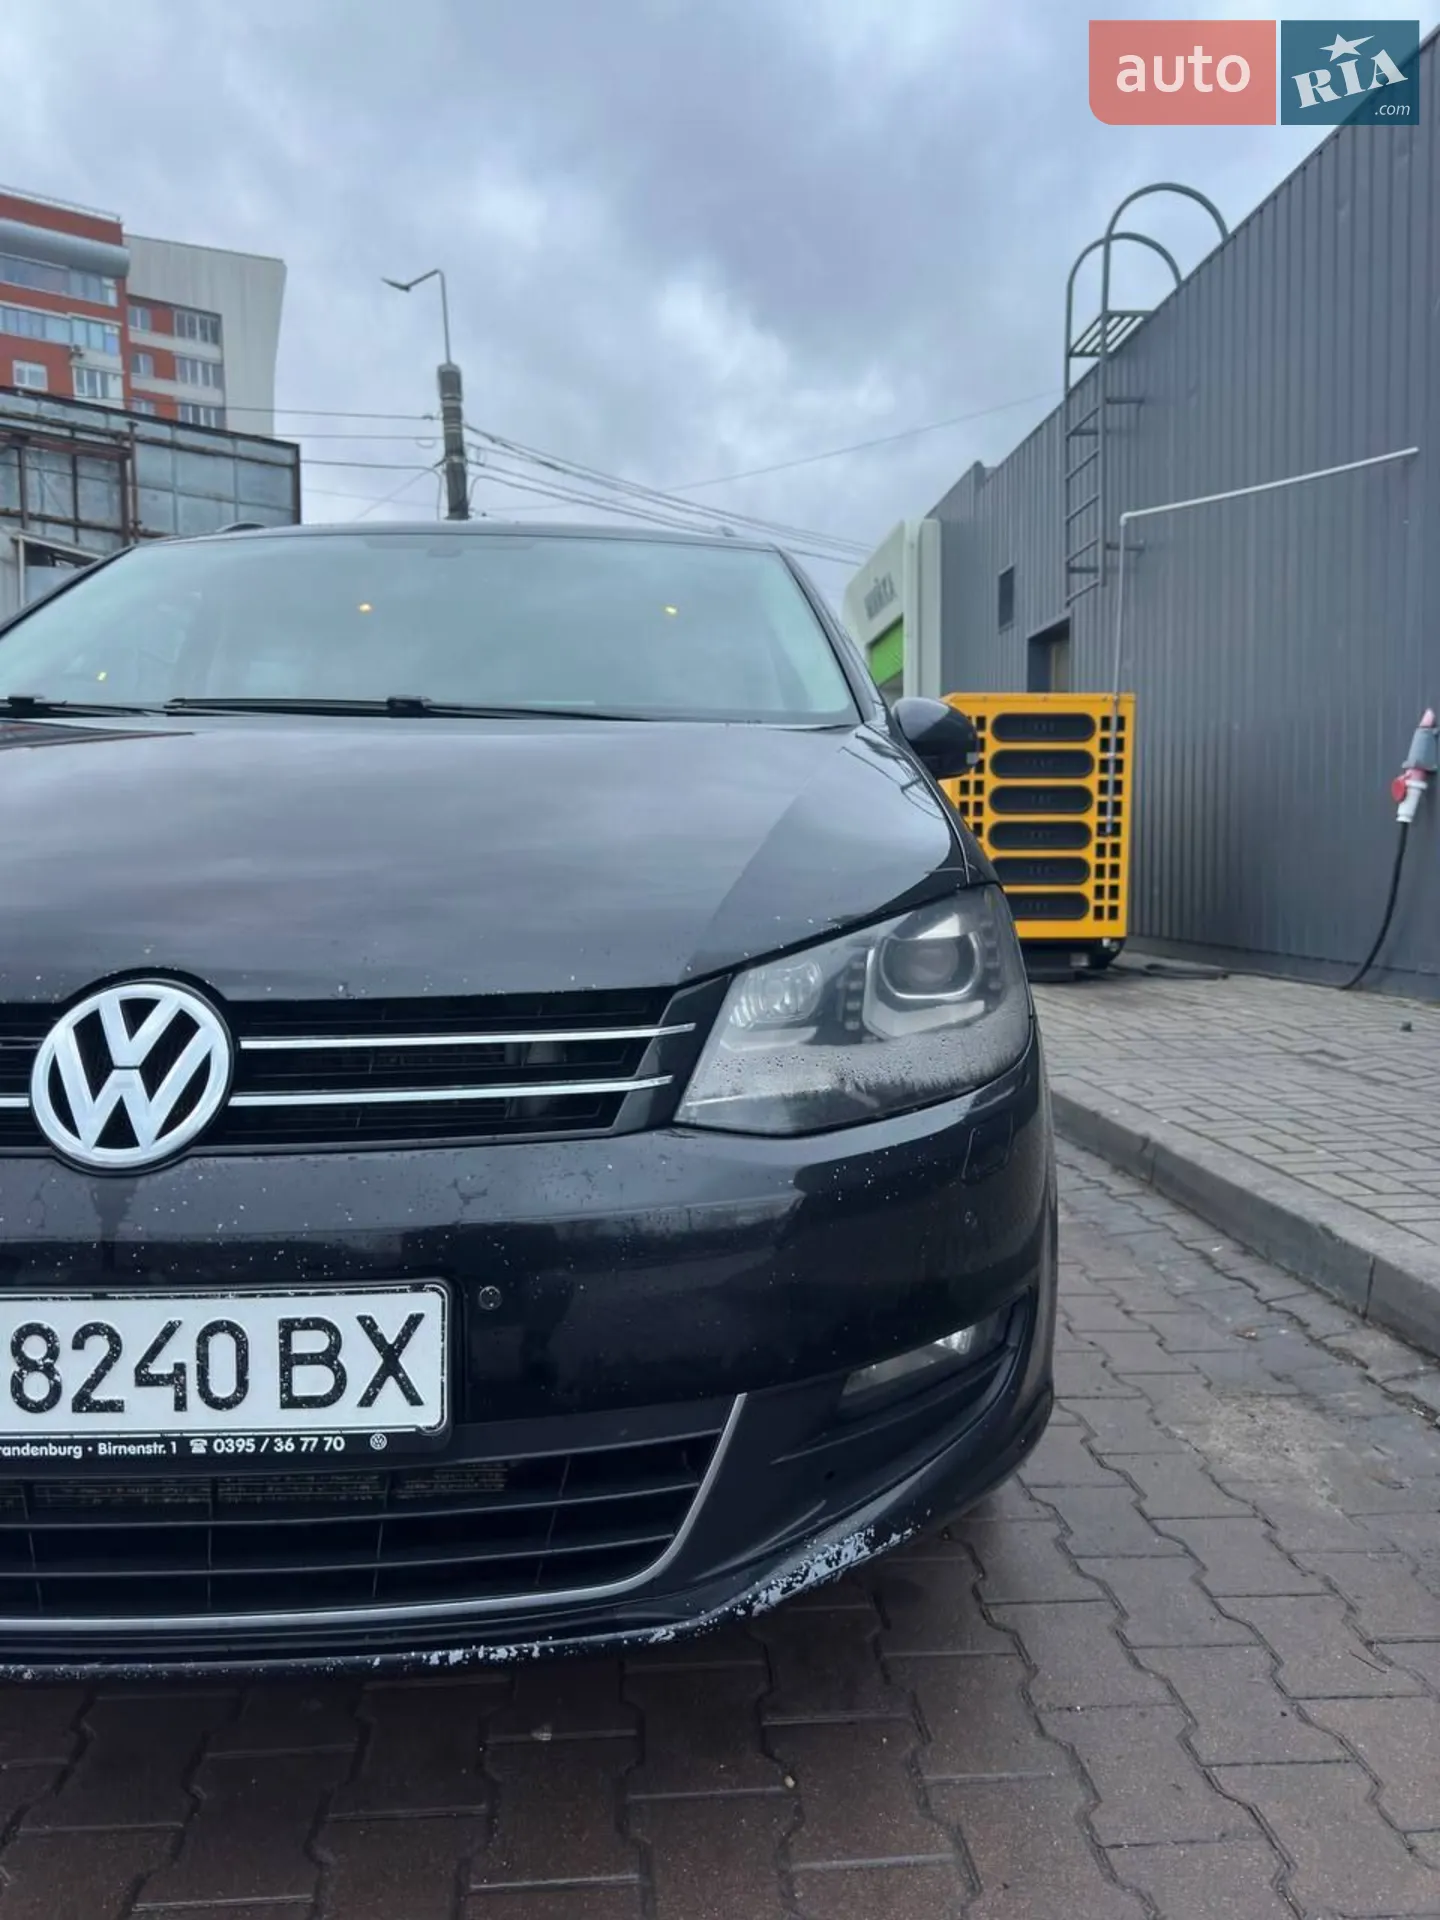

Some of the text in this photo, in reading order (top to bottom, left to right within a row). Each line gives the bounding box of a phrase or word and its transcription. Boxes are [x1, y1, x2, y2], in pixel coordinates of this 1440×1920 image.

[9, 1312, 425, 1413] 8240 BX
[97, 1441, 167, 1456] Birnenstr.
[170, 1441, 178, 1454] 1
[212, 1437, 256, 1454] 0395
[273, 1437, 295, 1452] 36
[299, 1436, 319, 1452] 77
[323, 1436, 345, 1452] 70
